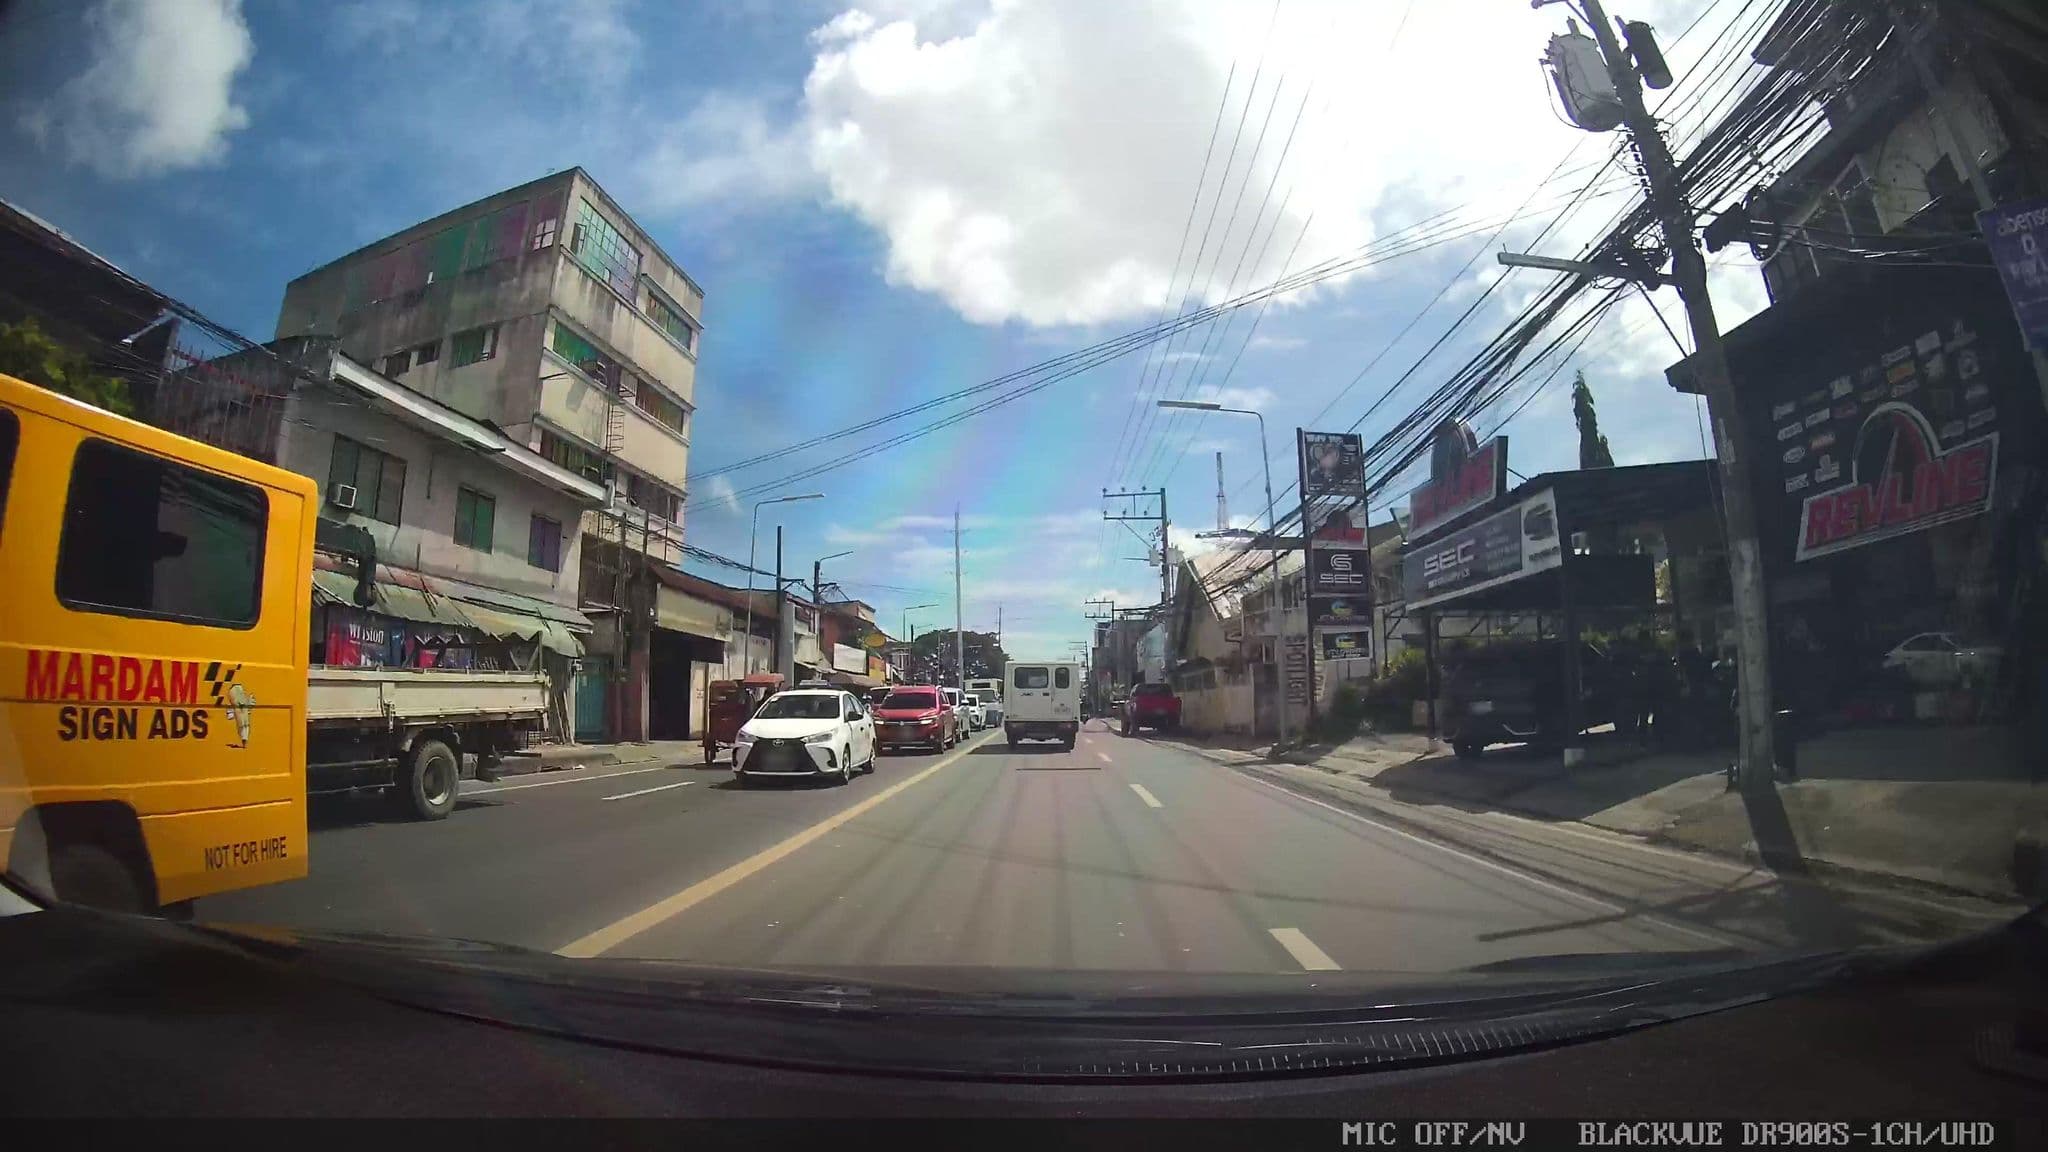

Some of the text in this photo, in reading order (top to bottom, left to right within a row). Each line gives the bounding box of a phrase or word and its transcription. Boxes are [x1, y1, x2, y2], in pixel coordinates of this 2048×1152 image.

[1805, 444, 1989, 549] REVLINE
[1423, 538, 1476, 578] SEC
[1319, 573, 1363, 584] SEC
[25, 649, 200, 705] MARDAM
[57, 706, 209, 742] SIGN ADS
[204, 836, 288, 871] NOT FOR HIRE
